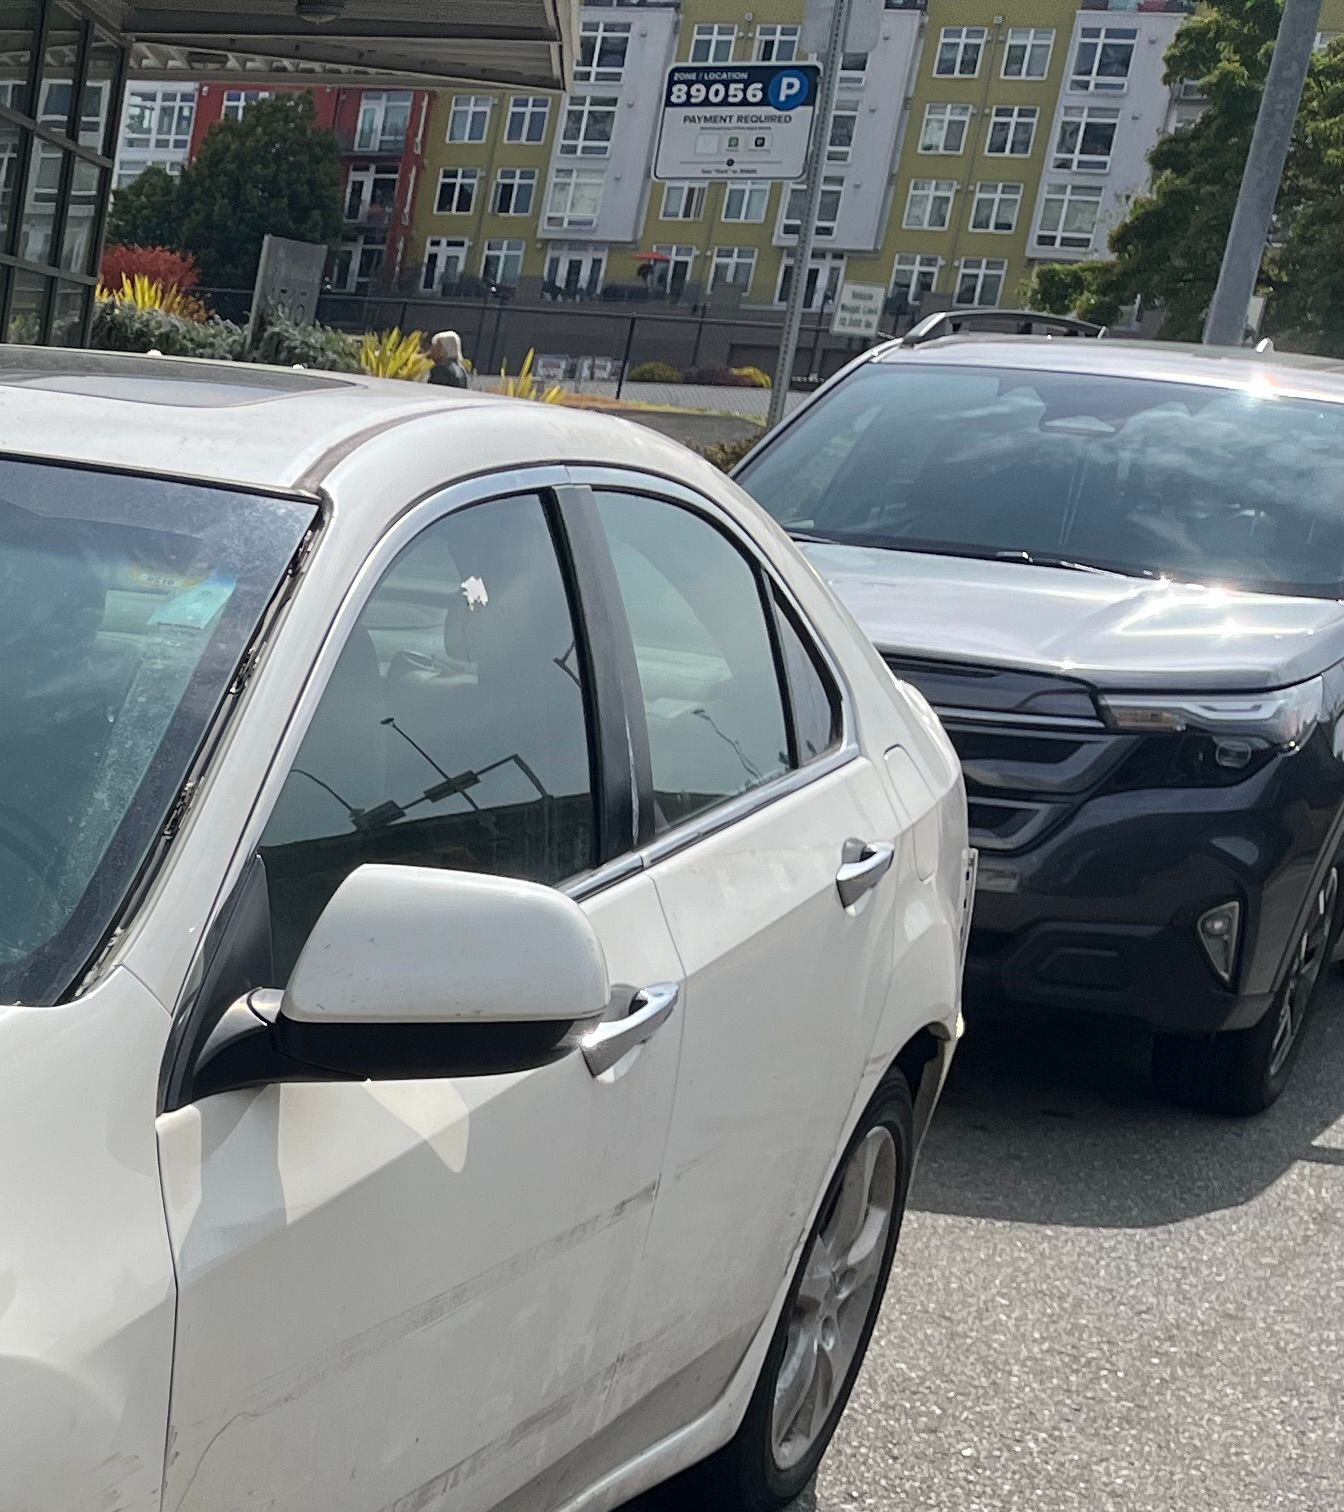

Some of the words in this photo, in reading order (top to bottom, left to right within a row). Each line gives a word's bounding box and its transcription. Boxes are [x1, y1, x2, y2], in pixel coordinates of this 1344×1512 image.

[673, 71, 697, 81] ZONE
[704, 71, 749, 81] LOCATION
[670, 82, 763, 103] 89056
[779, 76, 801, 102] P
[683, 114, 734, 124] PAYMENT
[736, 114, 792, 124] REQUIRED
